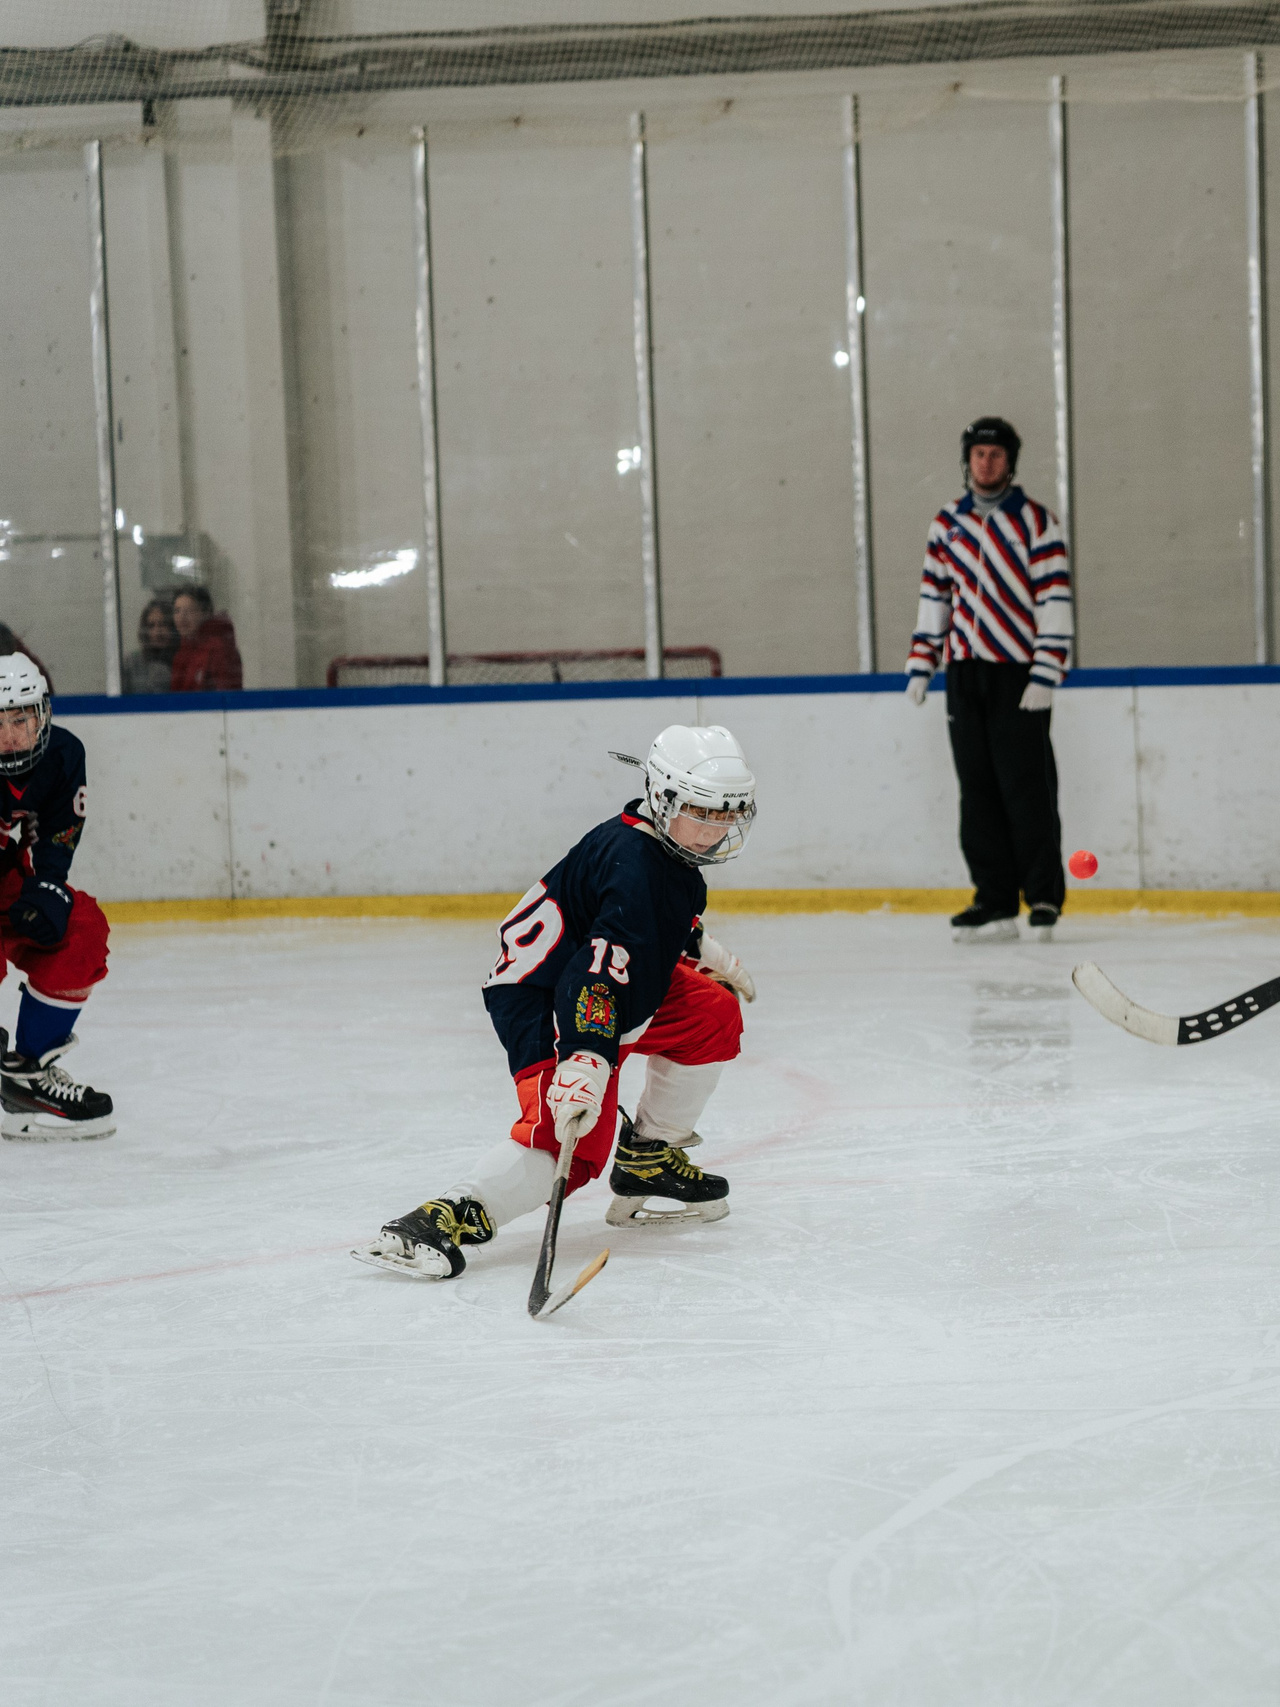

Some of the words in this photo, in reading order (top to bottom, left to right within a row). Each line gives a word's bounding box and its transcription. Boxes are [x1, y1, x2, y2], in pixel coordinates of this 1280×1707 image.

[587, 936, 631, 985] 19
[567, 1052, 602, 1070] TEX
[470, 1207, 487, 1237] BAUER
